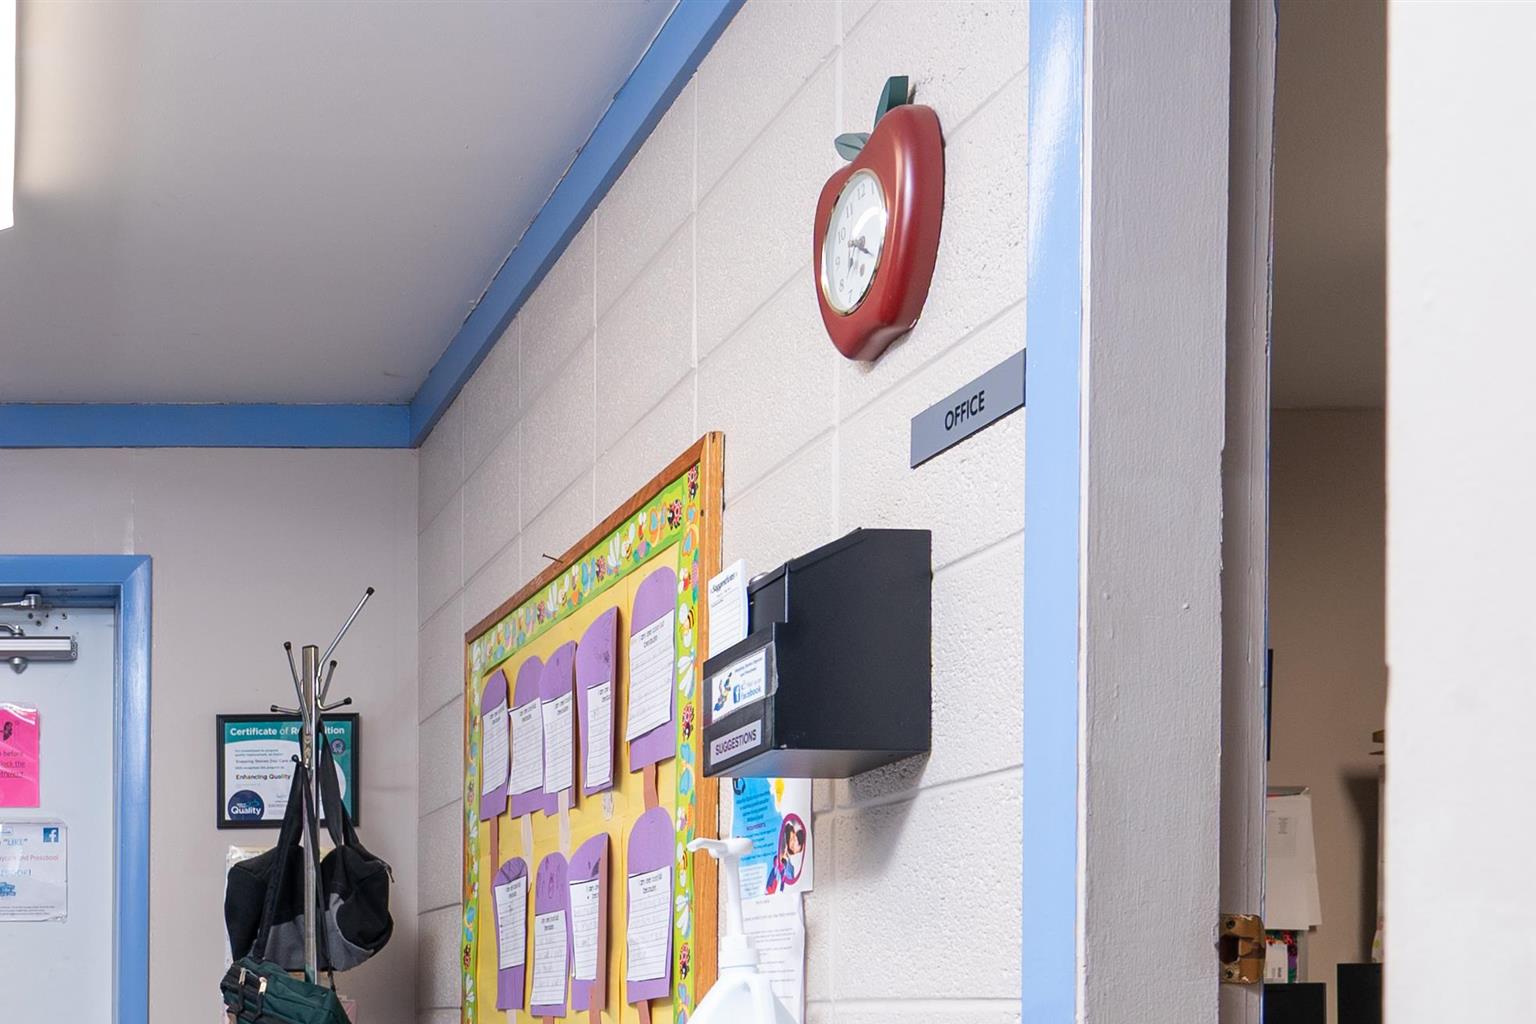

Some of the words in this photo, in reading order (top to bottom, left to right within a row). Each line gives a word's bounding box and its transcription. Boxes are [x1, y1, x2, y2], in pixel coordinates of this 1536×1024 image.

[857, 182, 866, 201] 12
[845, 204, 853, 219] 11
[837, 226, 846, 243] 10
[945, 390, 985, 431] OFFICE
[230, 727, 277, 736] Certificate
[279, 727, 289, 735] of
[715, 729, 757, 756] SUGGESTIONS
[231, 806, 262, 816] Quality
